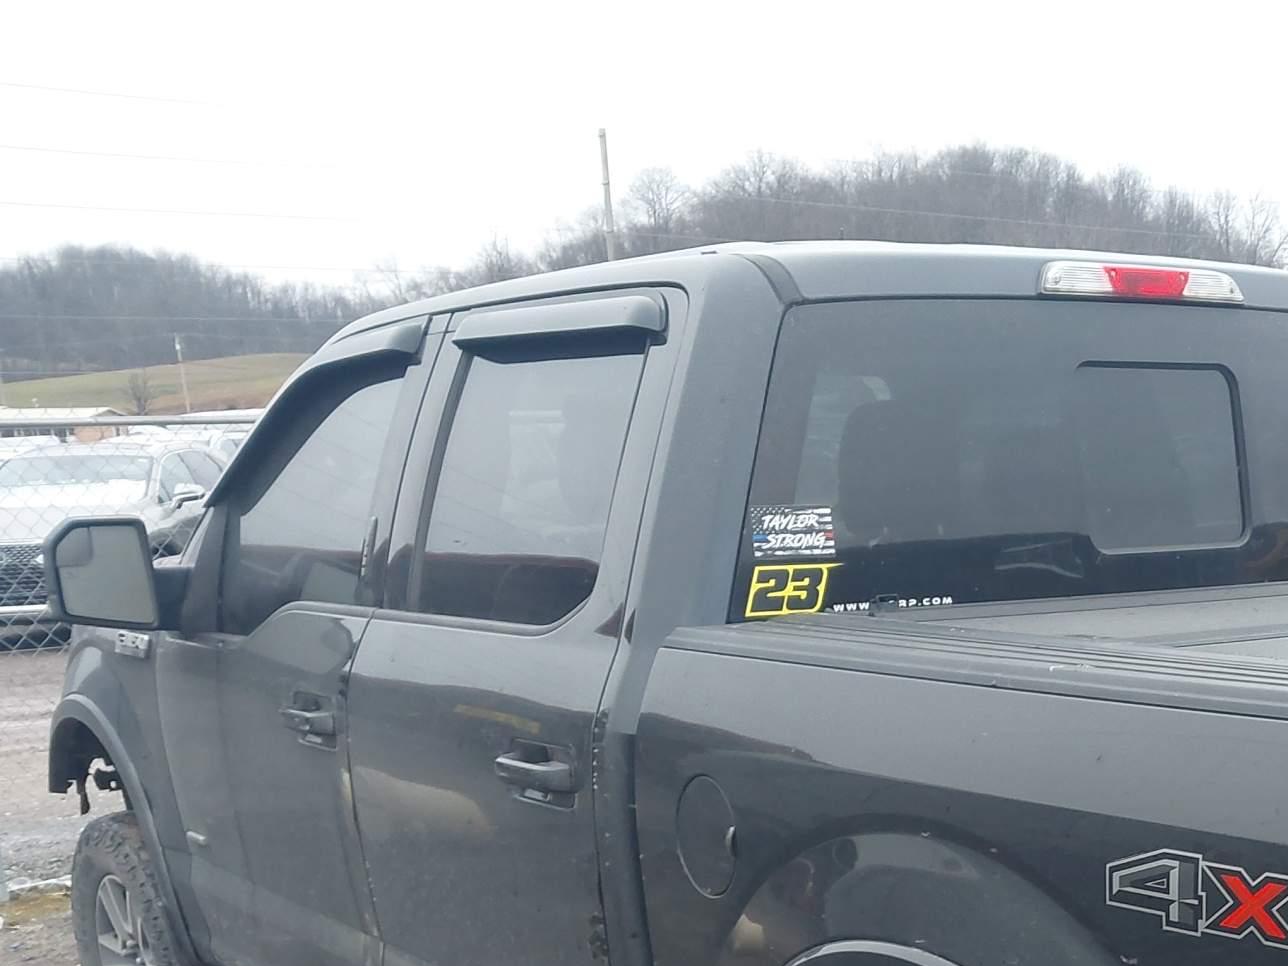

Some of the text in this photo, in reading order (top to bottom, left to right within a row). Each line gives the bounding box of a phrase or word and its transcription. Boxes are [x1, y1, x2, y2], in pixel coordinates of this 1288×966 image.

[761, 513, 820, 531] TAYLOR
[761, 531, 827, 549] STRONG
[745, 563, 835, 617] 23
